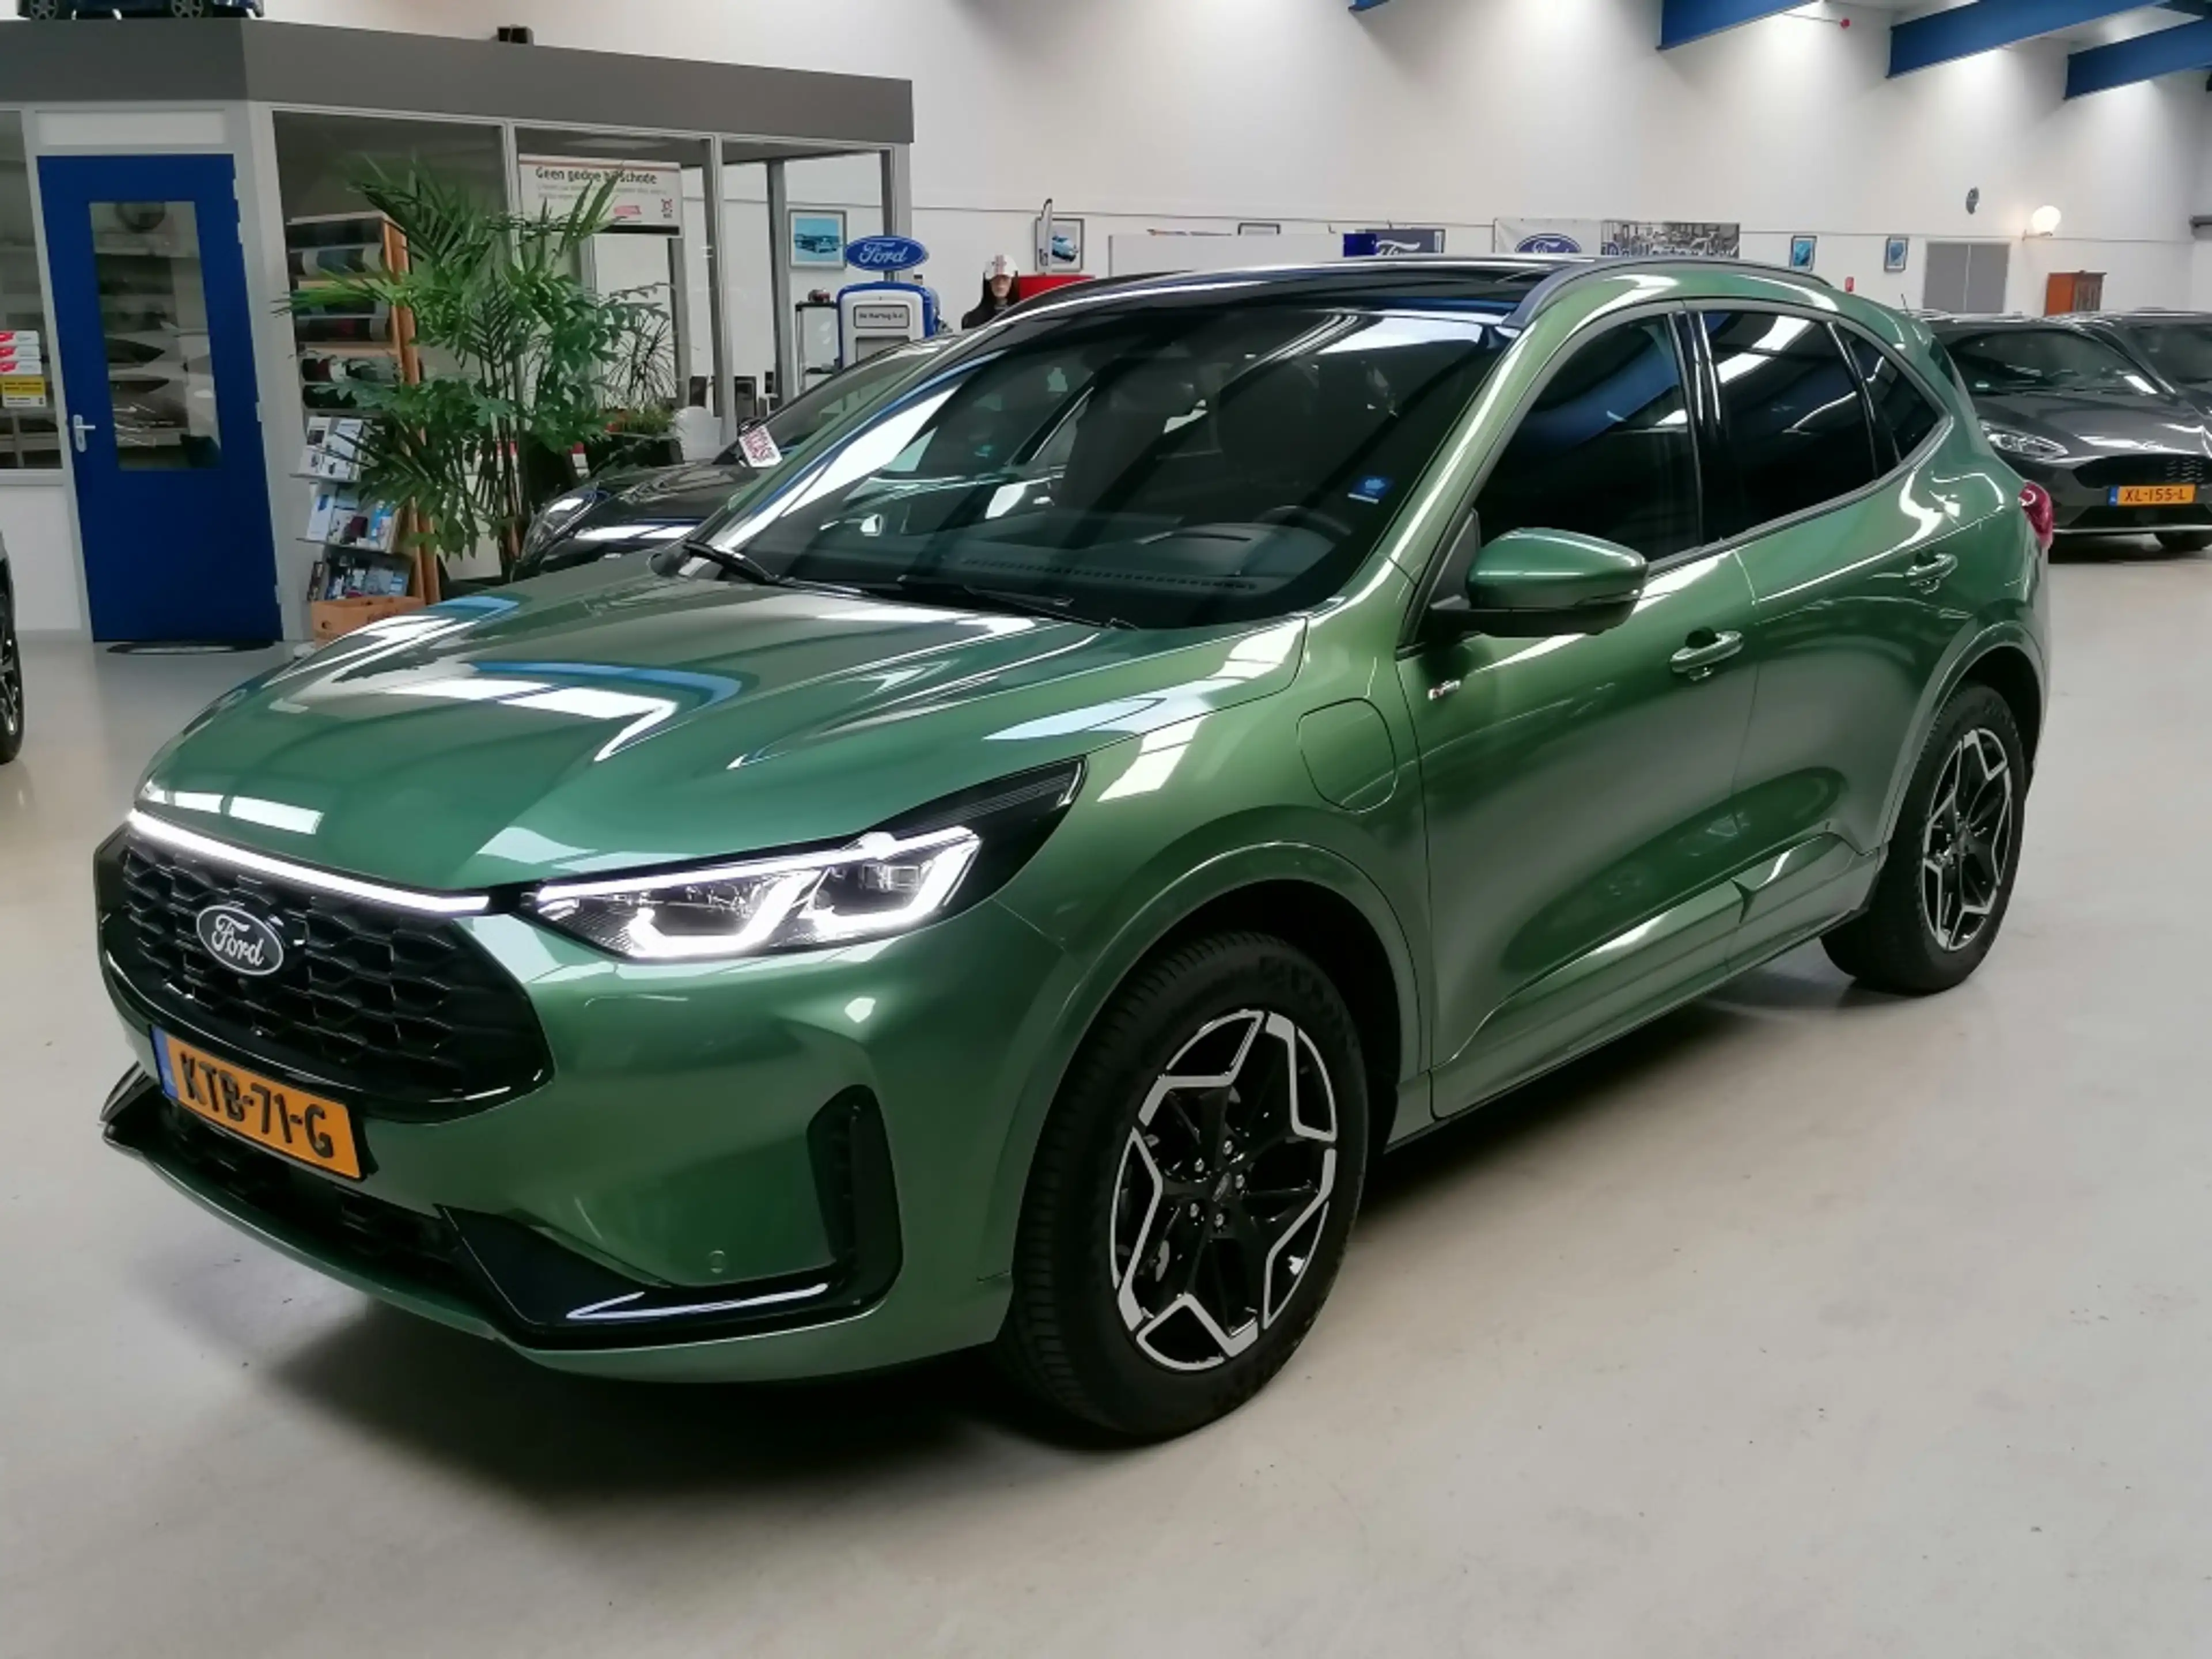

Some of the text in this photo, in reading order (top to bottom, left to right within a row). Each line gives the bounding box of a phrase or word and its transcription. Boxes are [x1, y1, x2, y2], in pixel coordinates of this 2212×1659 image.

[536, 166, 565, 179] Geen
[858, 241, 909, 264] Ford
[2124, 488, 2187, 502] XL-155-L
[211, 914, 264, 967] Ford
[180, 1051, 334, 1158] KTB-71-G
